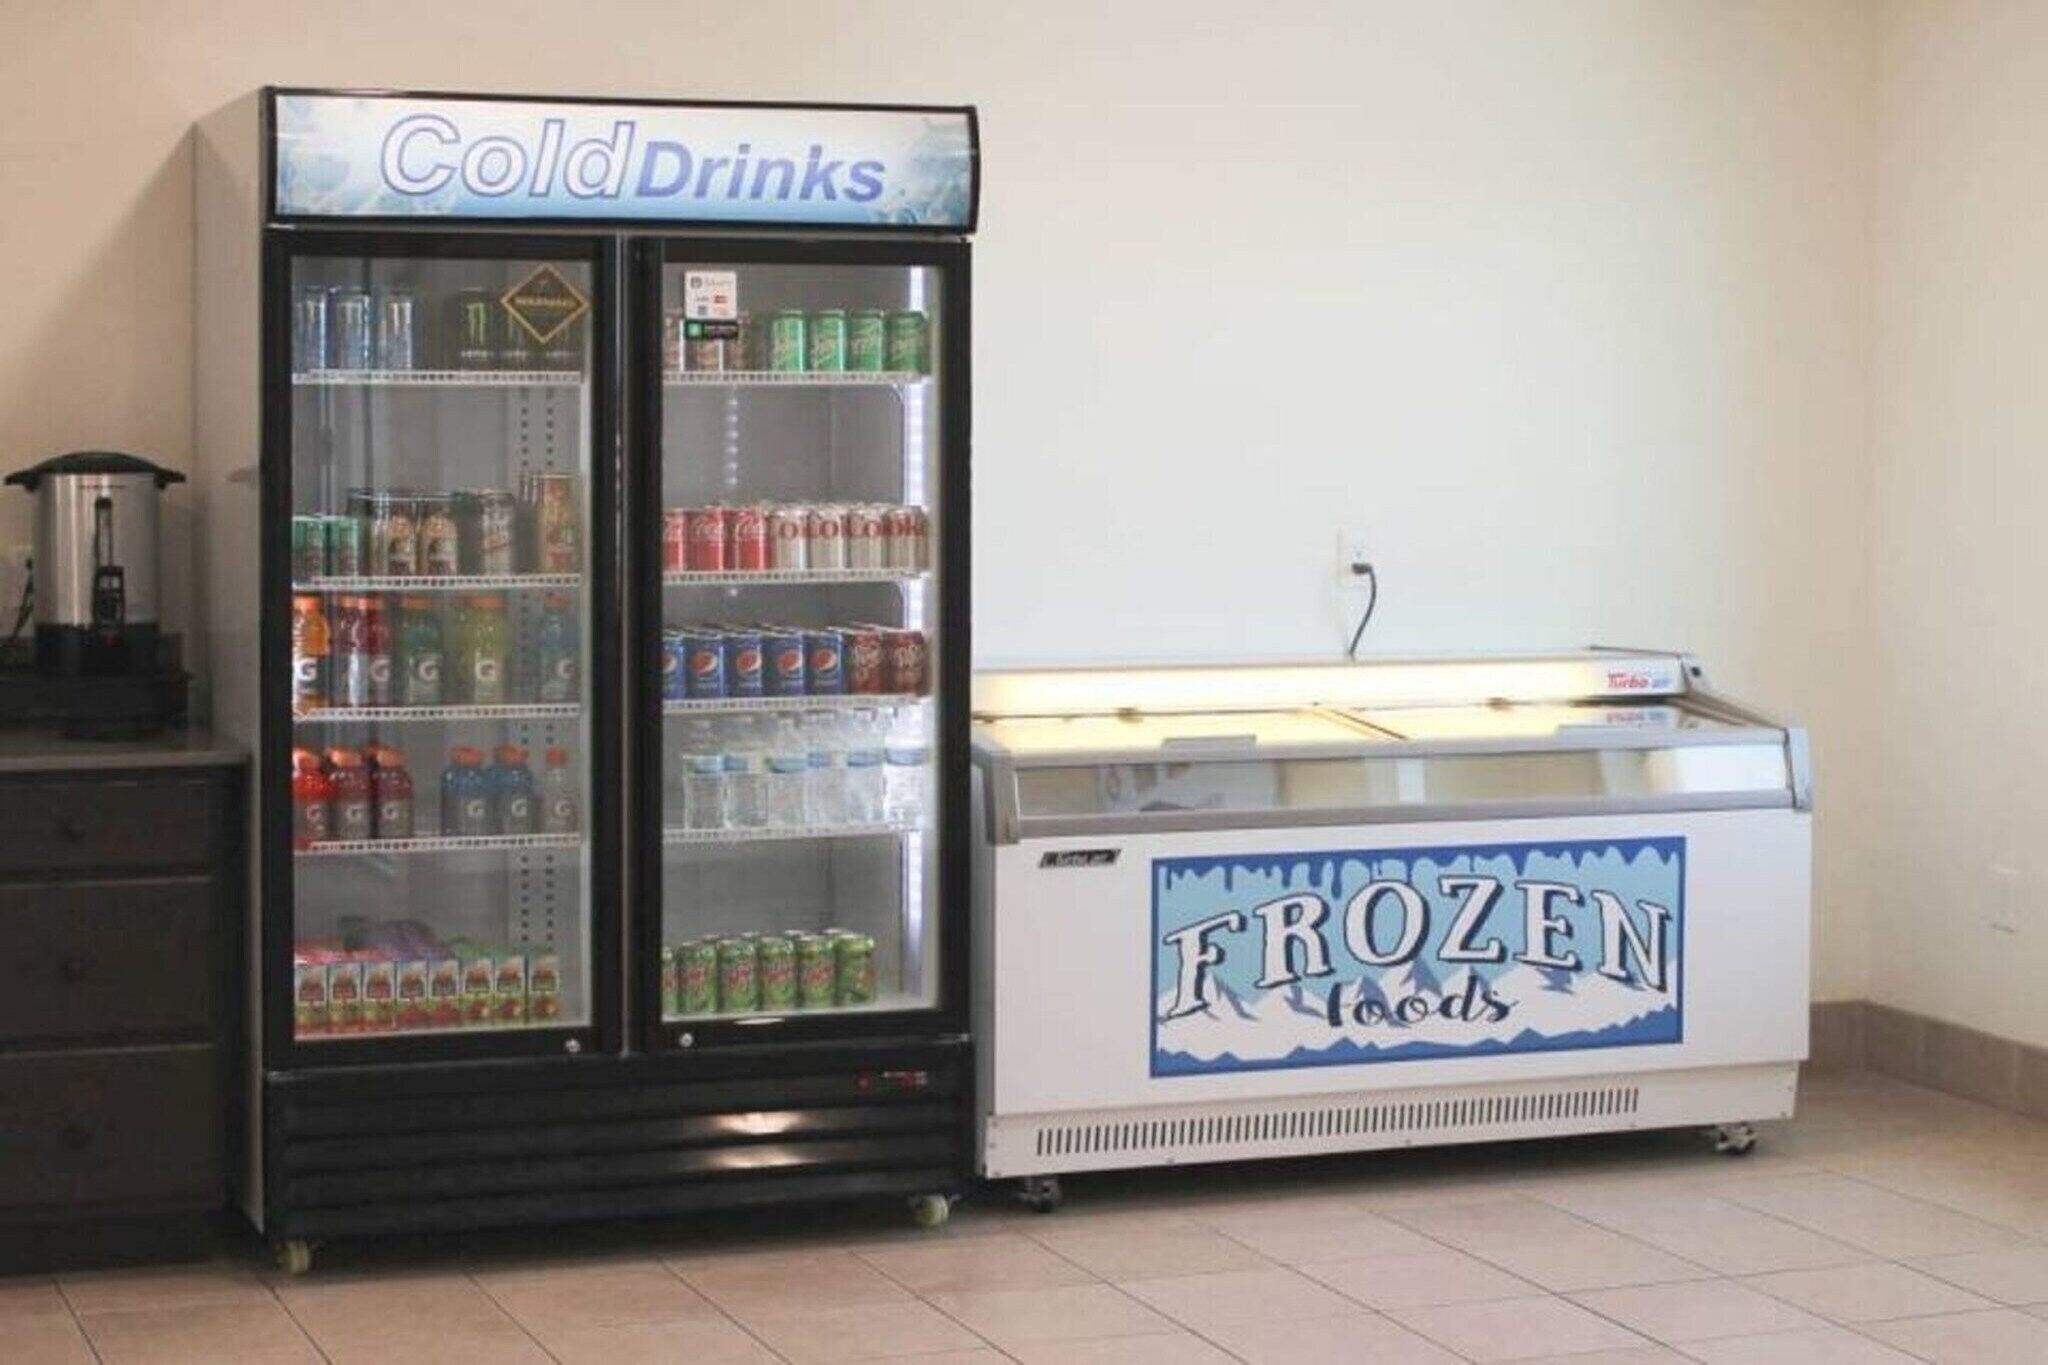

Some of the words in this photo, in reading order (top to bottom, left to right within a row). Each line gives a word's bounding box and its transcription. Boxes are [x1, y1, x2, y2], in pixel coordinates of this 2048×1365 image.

[381, 113, 636, 198] Cold
[635, 140, 887, 202] Drinks
[296, 658, 318, 682] G
[370, 659, 391, 682] G
[418, 660, 440, 682] G
[475, 658, 497, 682] G
[382, 801, 399, 821] G
[467, 800, 486, 818] G
[511, 798, 528, 817] G
[1163, 875, 1672, 1019] FROZEN
